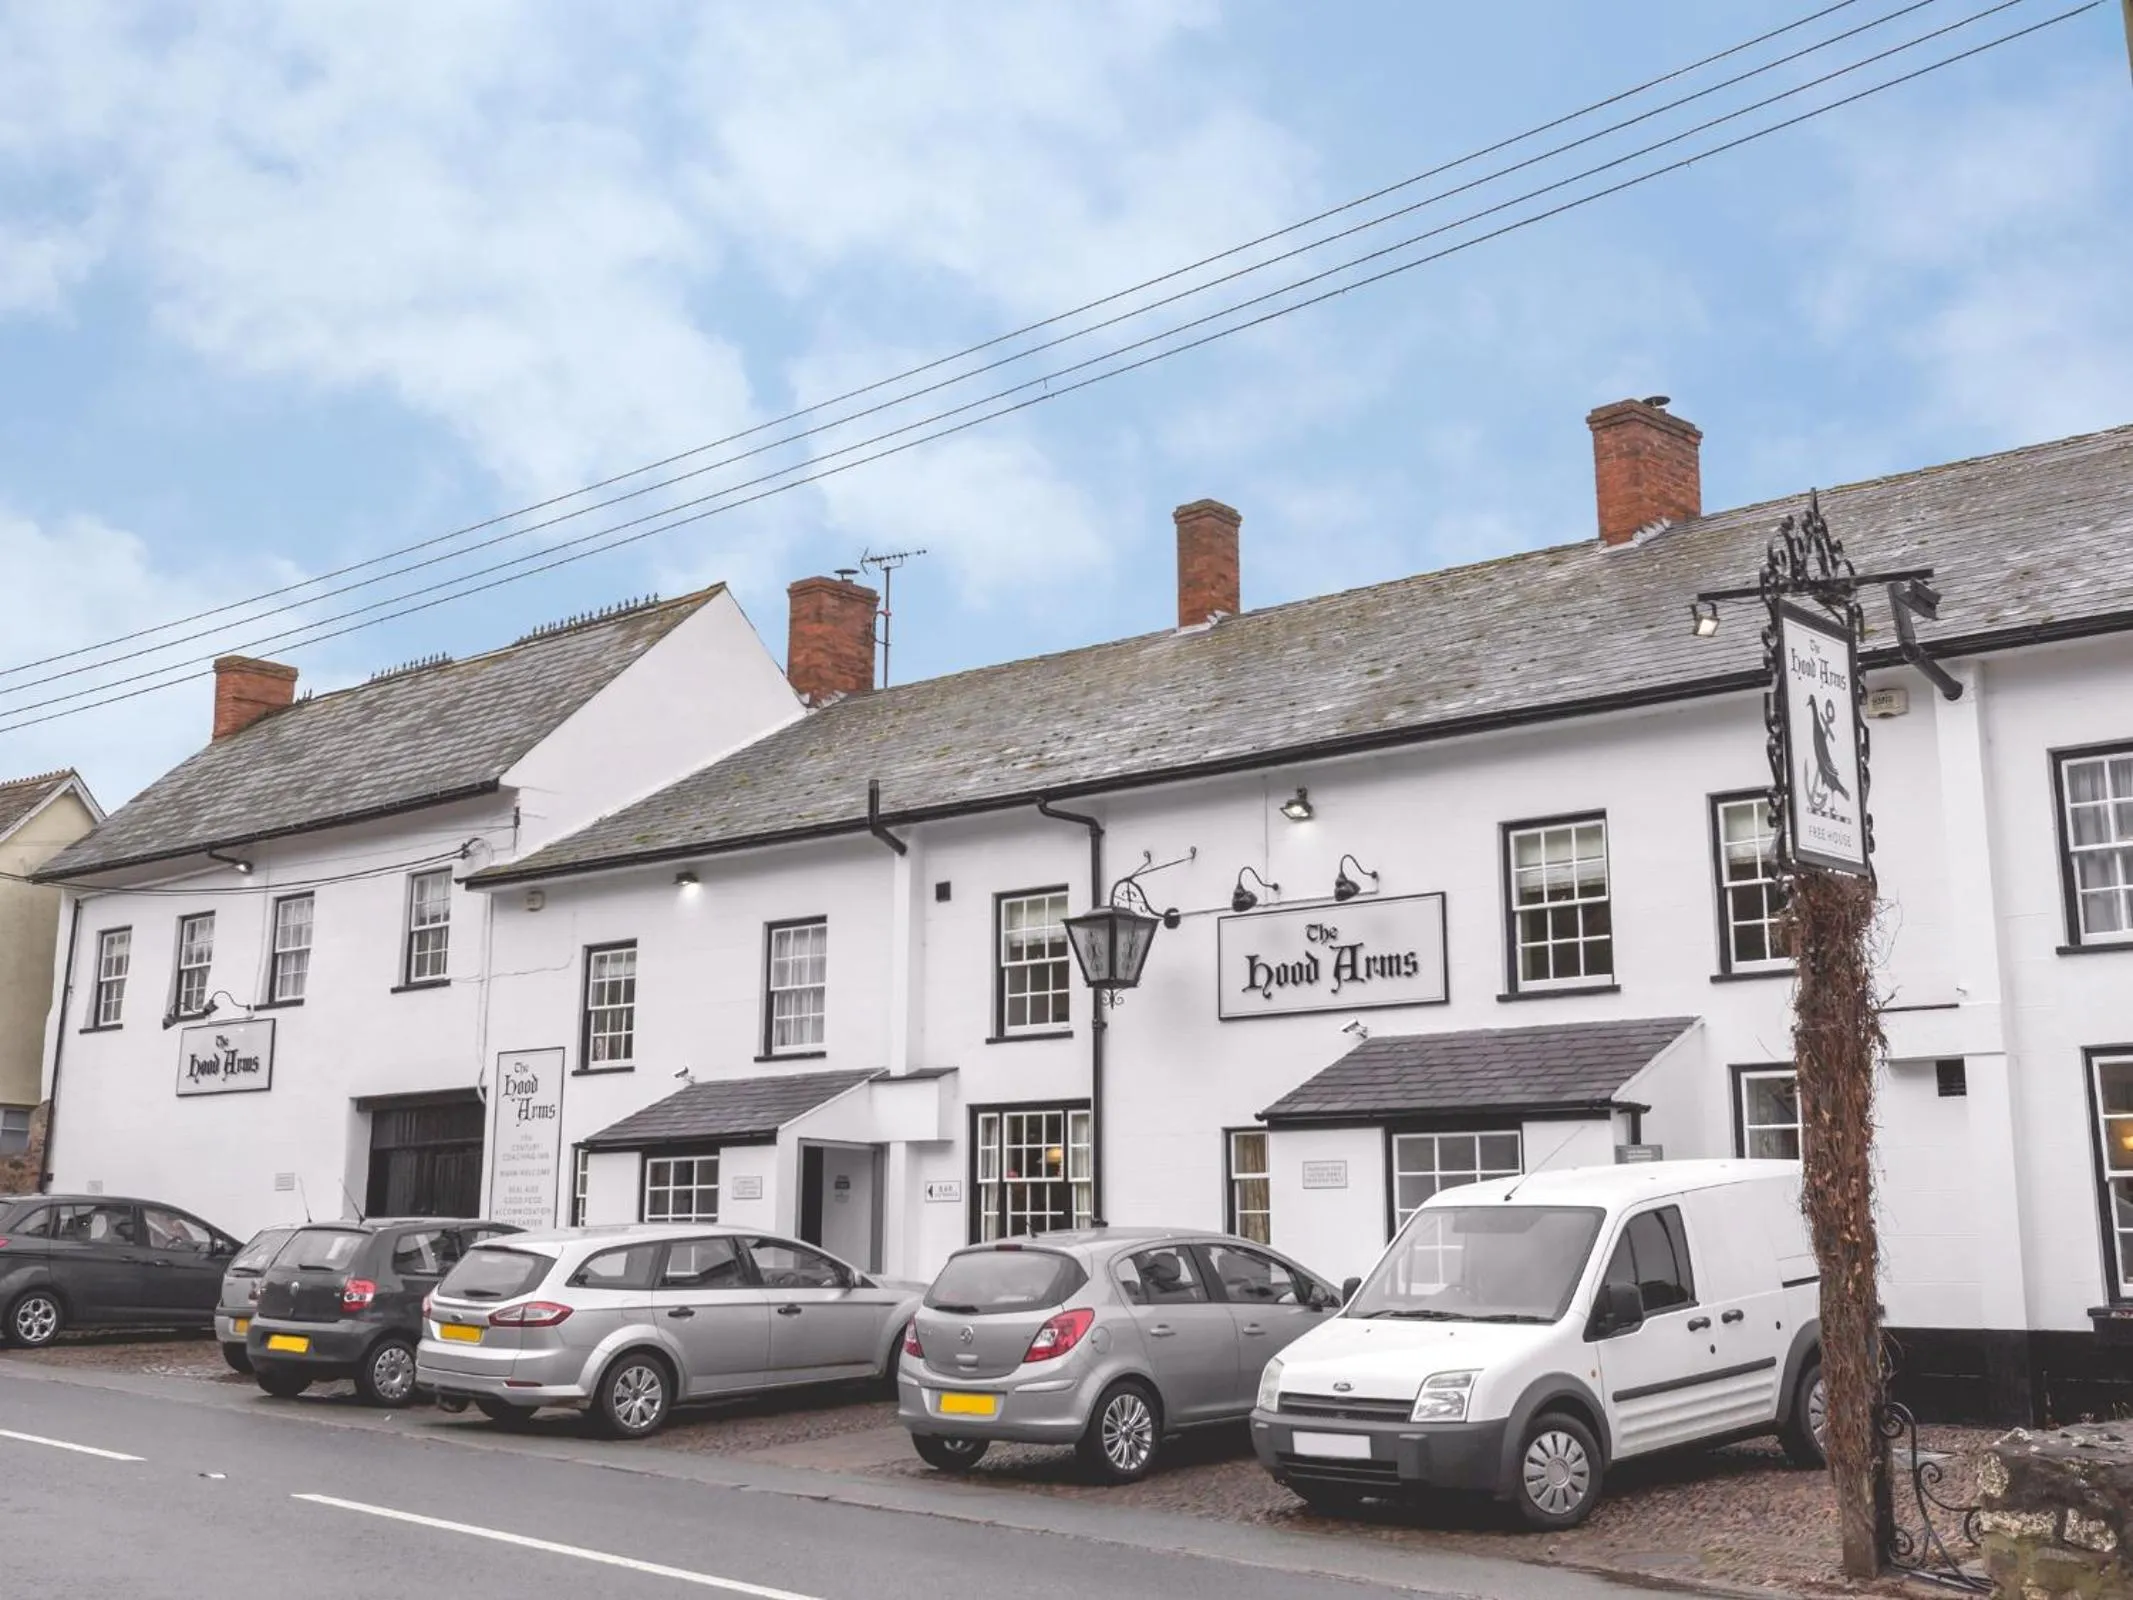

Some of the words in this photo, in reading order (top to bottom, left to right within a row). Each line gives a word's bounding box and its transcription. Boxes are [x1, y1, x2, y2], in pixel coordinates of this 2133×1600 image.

[1791, 647, 1817, 680] Hood
[1818, 657, 1847, 691] Arms
[1808, 825, 1826, 841] FREE
[1826, 829, 1852, 848] HOUSE
[1305, 923, 1339, 944] The
[1241, 950, 1321, 999] Hood
[1329, 942, 1420, 994] Arms
[215, 1034, 229, 1049] The
[186, 1053, 220, 1084] Hood
[221, 1049, 260, 1082] Arms
[514, 1062, 529, 1075] The
[502, 1073, 539, 1102] Hood
[515, 1097, 556, 1127] Arms
